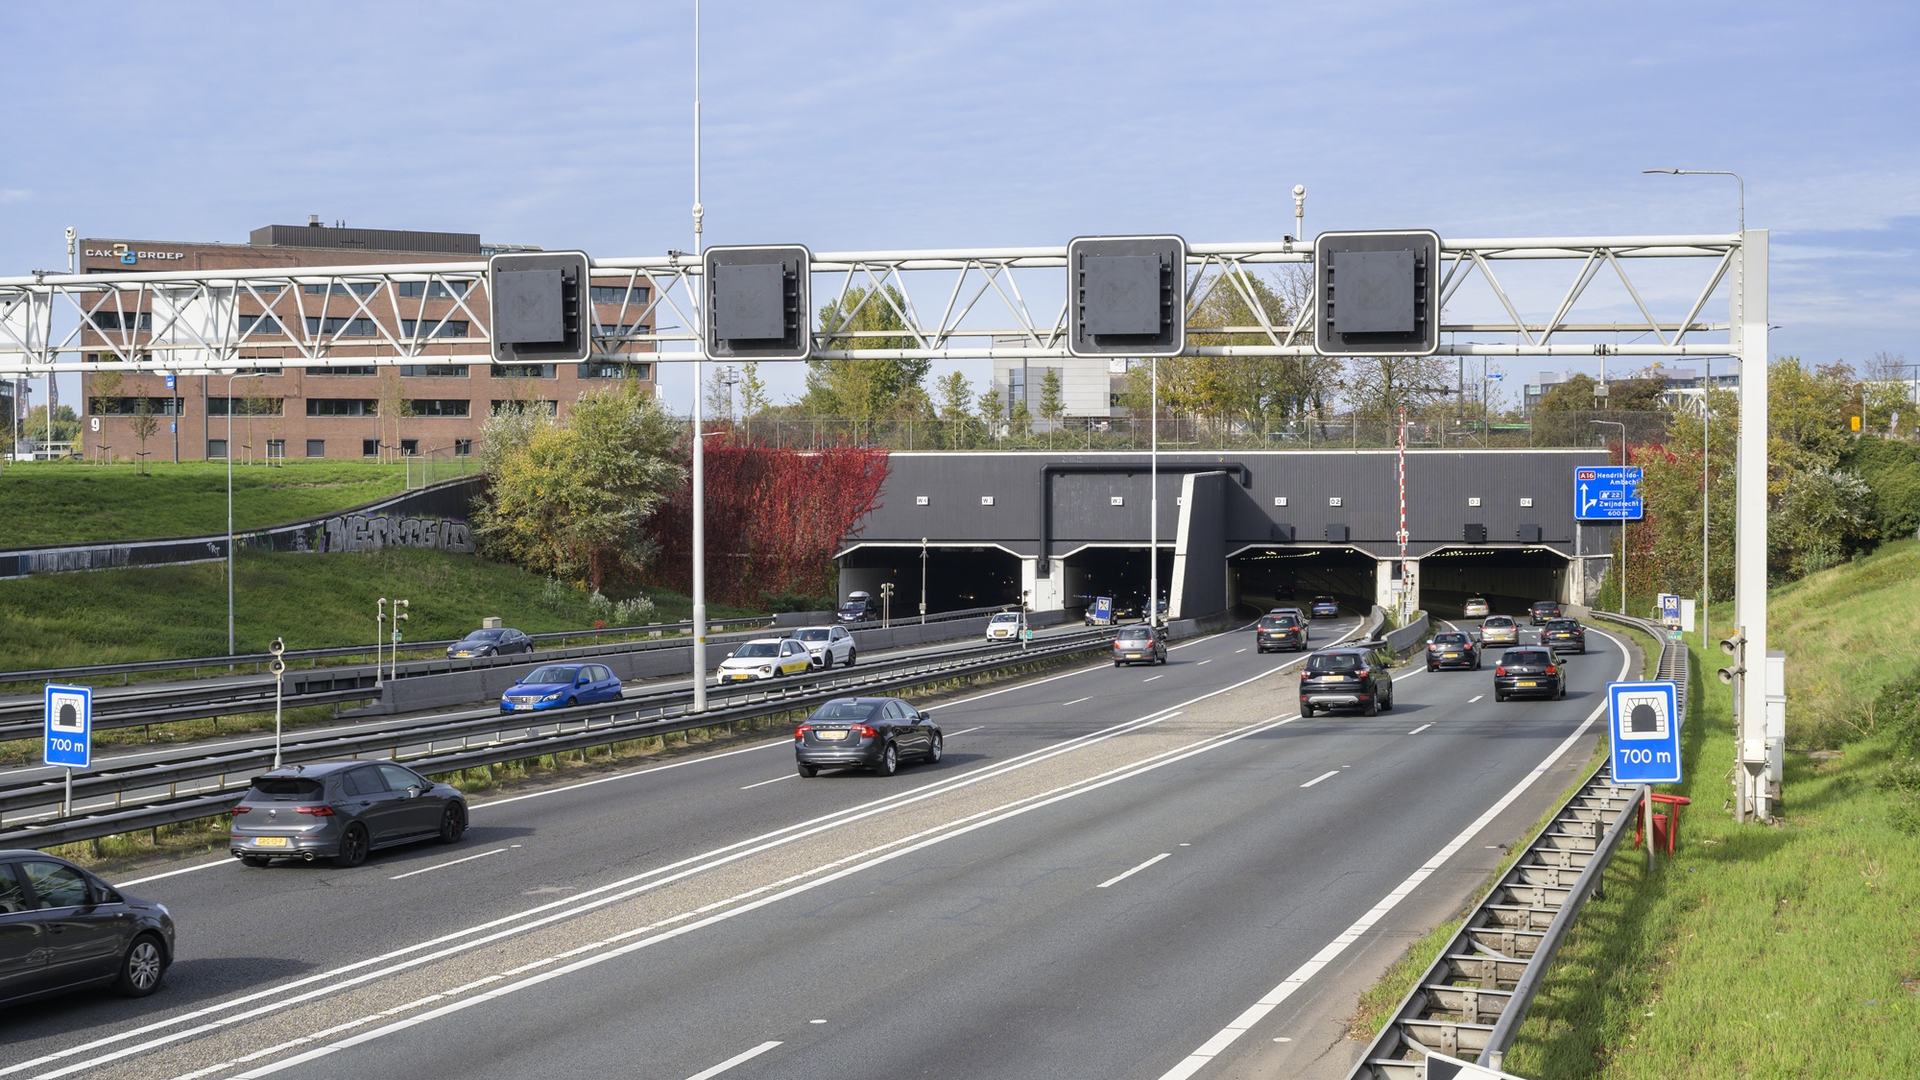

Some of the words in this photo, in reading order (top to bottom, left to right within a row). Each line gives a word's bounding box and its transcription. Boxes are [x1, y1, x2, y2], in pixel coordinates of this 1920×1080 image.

[85, 249, 112, 257] CAK
[137, 251, 184, 259] GROEP
[90, 417, 100, 432] 9
[50, 738, 72, 752] 700
[74, 742, 84, 753] m
[1619, 749, 1652, 764] 700
[1656, 751, 1671, 763] m
